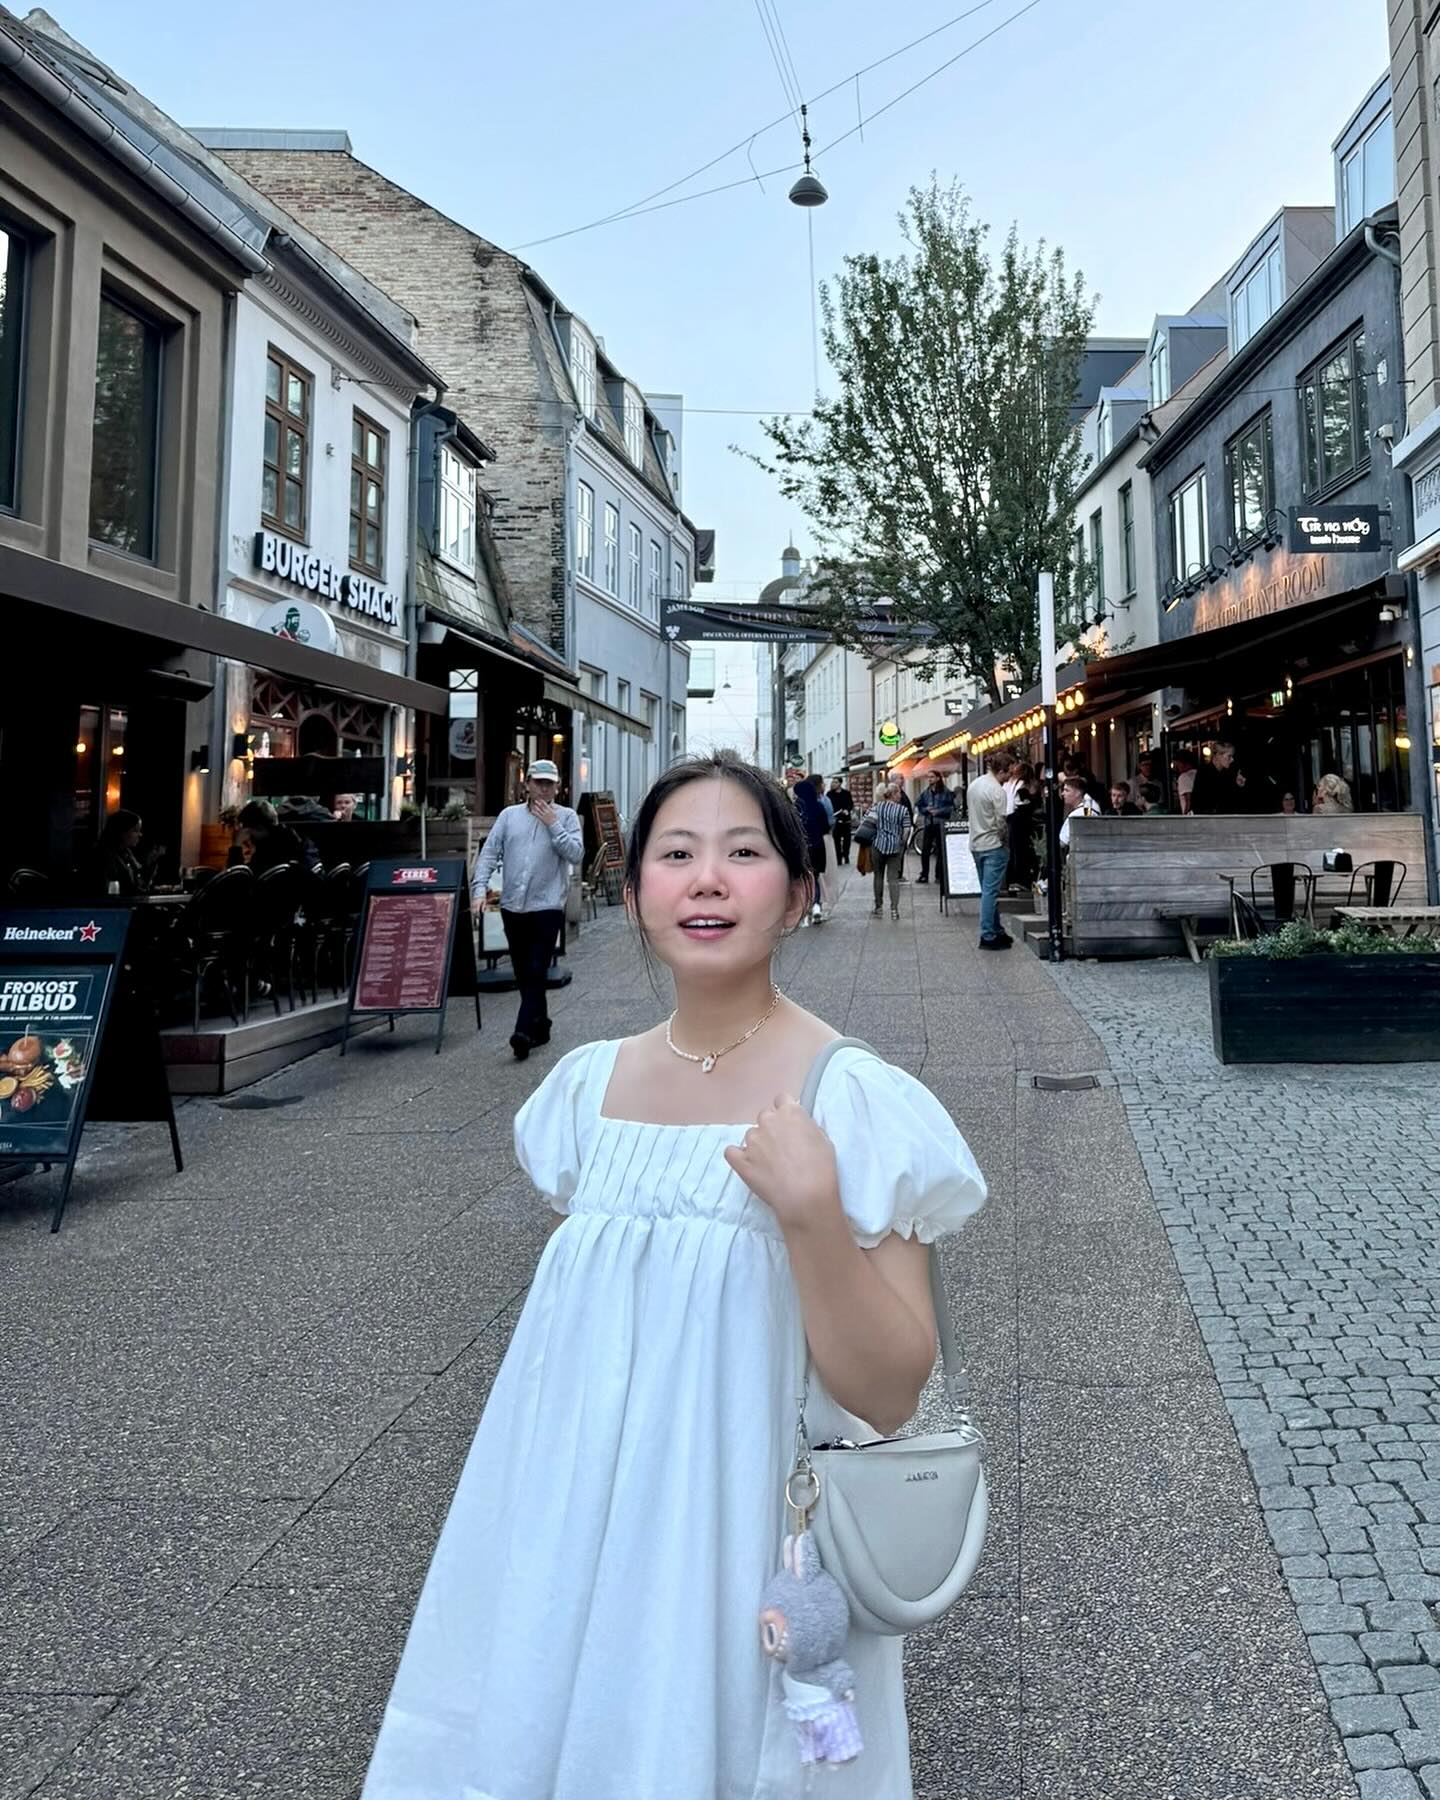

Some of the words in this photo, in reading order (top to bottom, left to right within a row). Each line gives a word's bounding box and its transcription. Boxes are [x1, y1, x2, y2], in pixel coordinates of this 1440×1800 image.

[261, 532, 341, 602] BURGER
[347, 575, 400, 626] SHACK
[1282, 557, 1326, 604] ROOM
[666, 602, 705, 614] JAMESON
[702, 631, 735, 639] DISCOUNTS
[401, 870, 429, 880] CERES
[4, 926, 75, 940] Heineken
[3, 981, 78, 994] FROKOST
[0, 993, 77, 1011] TILBUD
